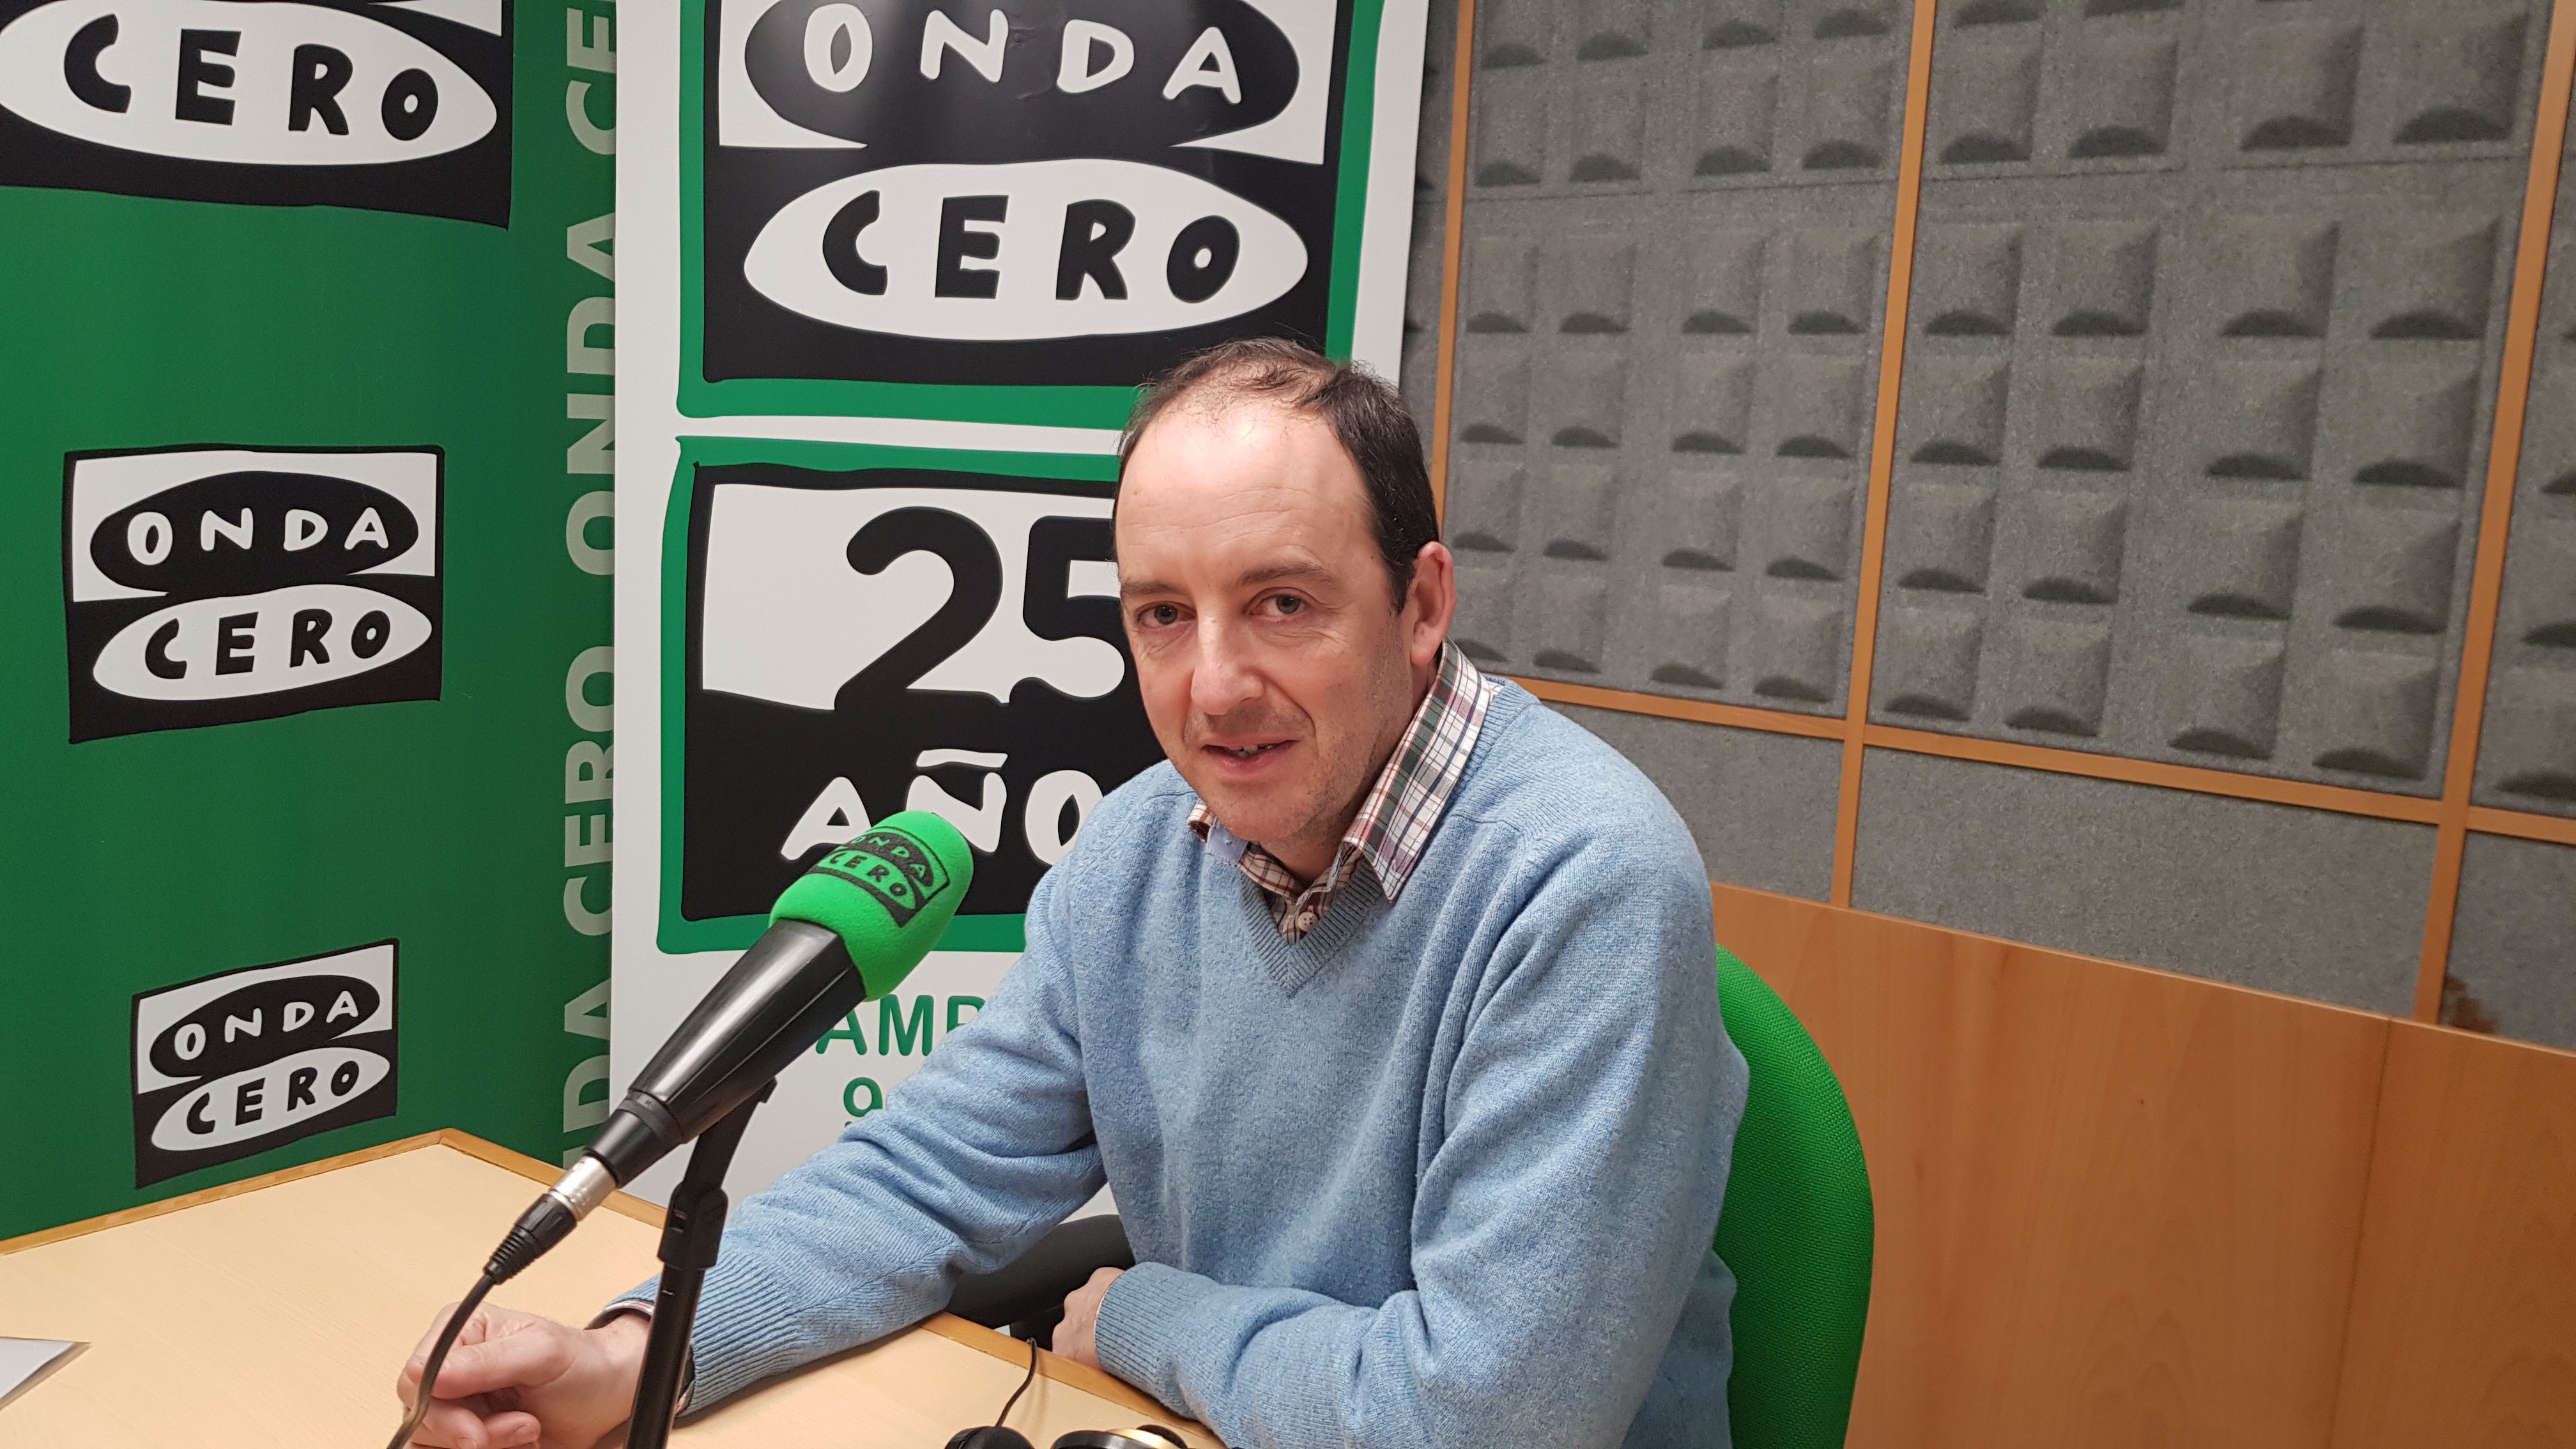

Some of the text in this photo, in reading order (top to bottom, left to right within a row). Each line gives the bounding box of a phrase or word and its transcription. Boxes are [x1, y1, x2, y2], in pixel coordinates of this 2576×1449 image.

[64, 13, 439, 141] CERO
[804, 3, 1241, 104] ONDA
[822, 190, 1240, 303] CERO
[128, 508, 388, 565] ONDA
[562, 0, 617, 1169] DA CERO ONDA CE
[834, 506, 1130, 710] 25
[145, 609, 390, 679] CERO
[830, 852, 907, 896] CERO
[851, 836, 926, 878] ONDA
[174, 991, 358, 1060] ONDA
[187, 1061, 359, 1135] CERO
